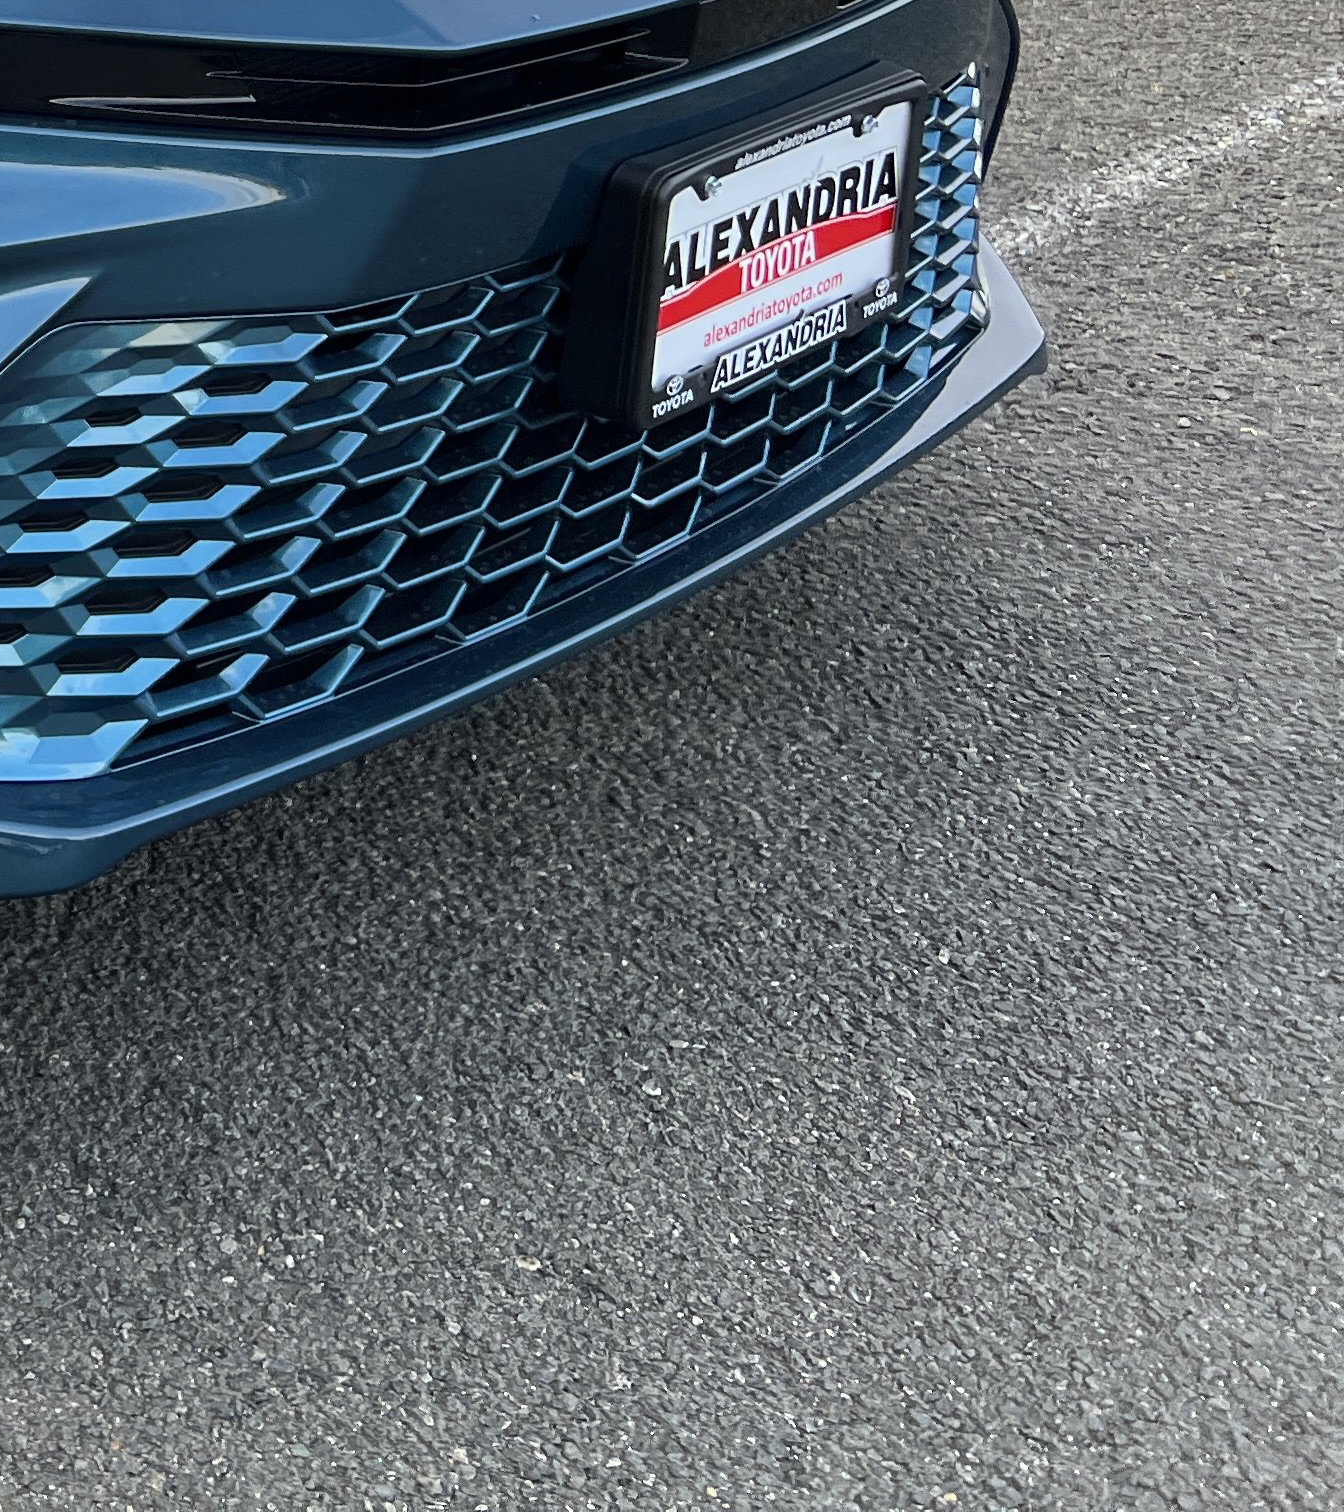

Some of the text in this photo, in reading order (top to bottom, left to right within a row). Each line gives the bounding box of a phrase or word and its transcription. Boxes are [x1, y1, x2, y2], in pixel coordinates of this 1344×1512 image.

[735, 115, 852, 170] alexandriatoyota.com
[662, 152, 897, 291] ALEXANDRIA
[739, 231, 817, 293] TOYOTA
[704, 272, 843, 347] alexandriatoyota.com
[863, 291, 898, 319] TOYOTA
[713, 301, 847, 391] ALEXANDRIA
[652, 388, 694, 418] TOYOTA
